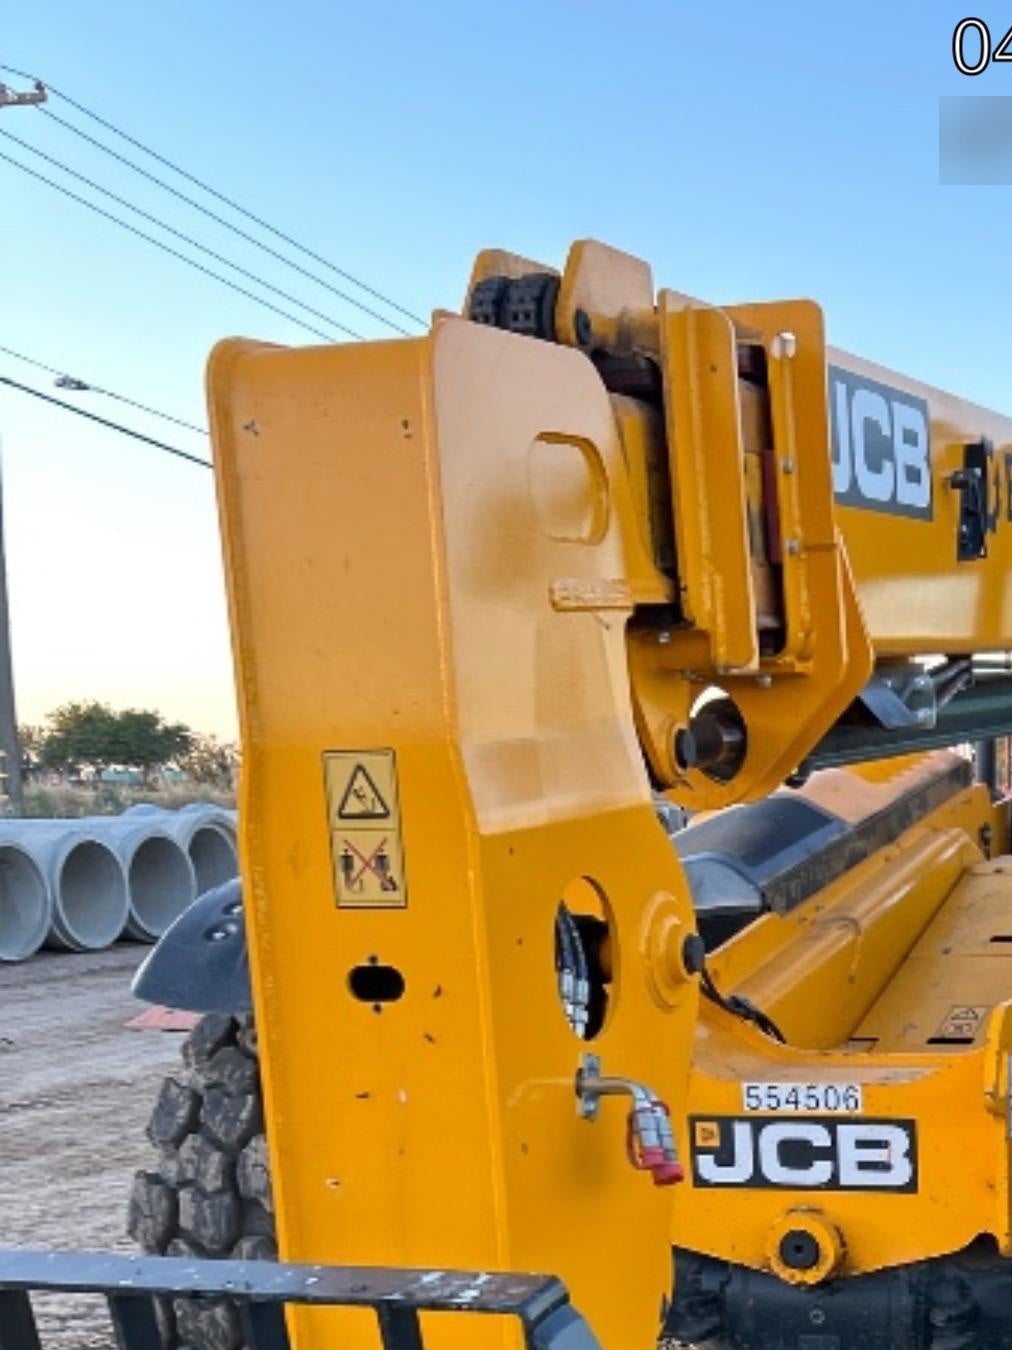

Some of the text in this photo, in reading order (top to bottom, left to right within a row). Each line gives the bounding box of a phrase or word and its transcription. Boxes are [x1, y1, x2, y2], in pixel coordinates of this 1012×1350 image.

[832, 381, 931, 508] JCB
[745, 1085, 860, 1111] 554506
[695, 1120, 913, 1186] JCB
